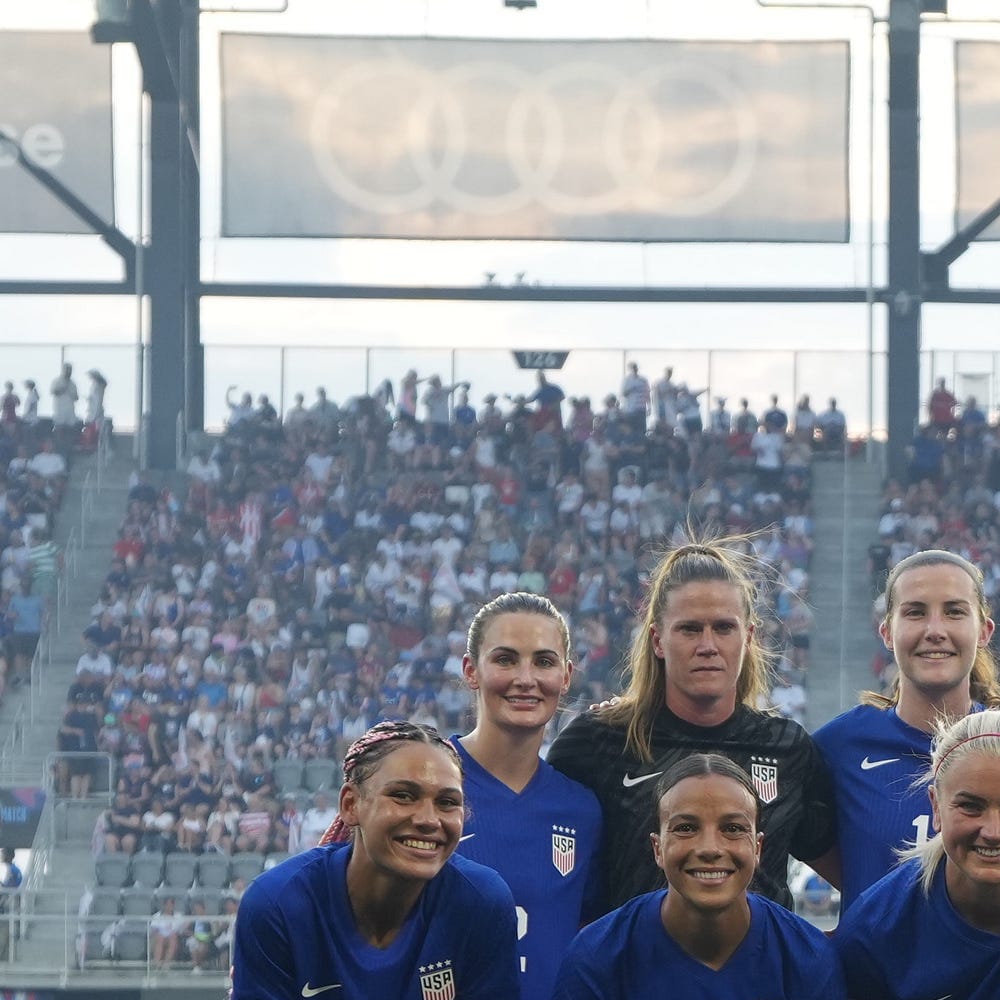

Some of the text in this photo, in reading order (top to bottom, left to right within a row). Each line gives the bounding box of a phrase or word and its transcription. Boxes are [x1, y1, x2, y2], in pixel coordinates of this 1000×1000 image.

[753, 765, 775, 782] USA
[554, 835, 573, 853] USA
[422, 971, 451, 990] USA
